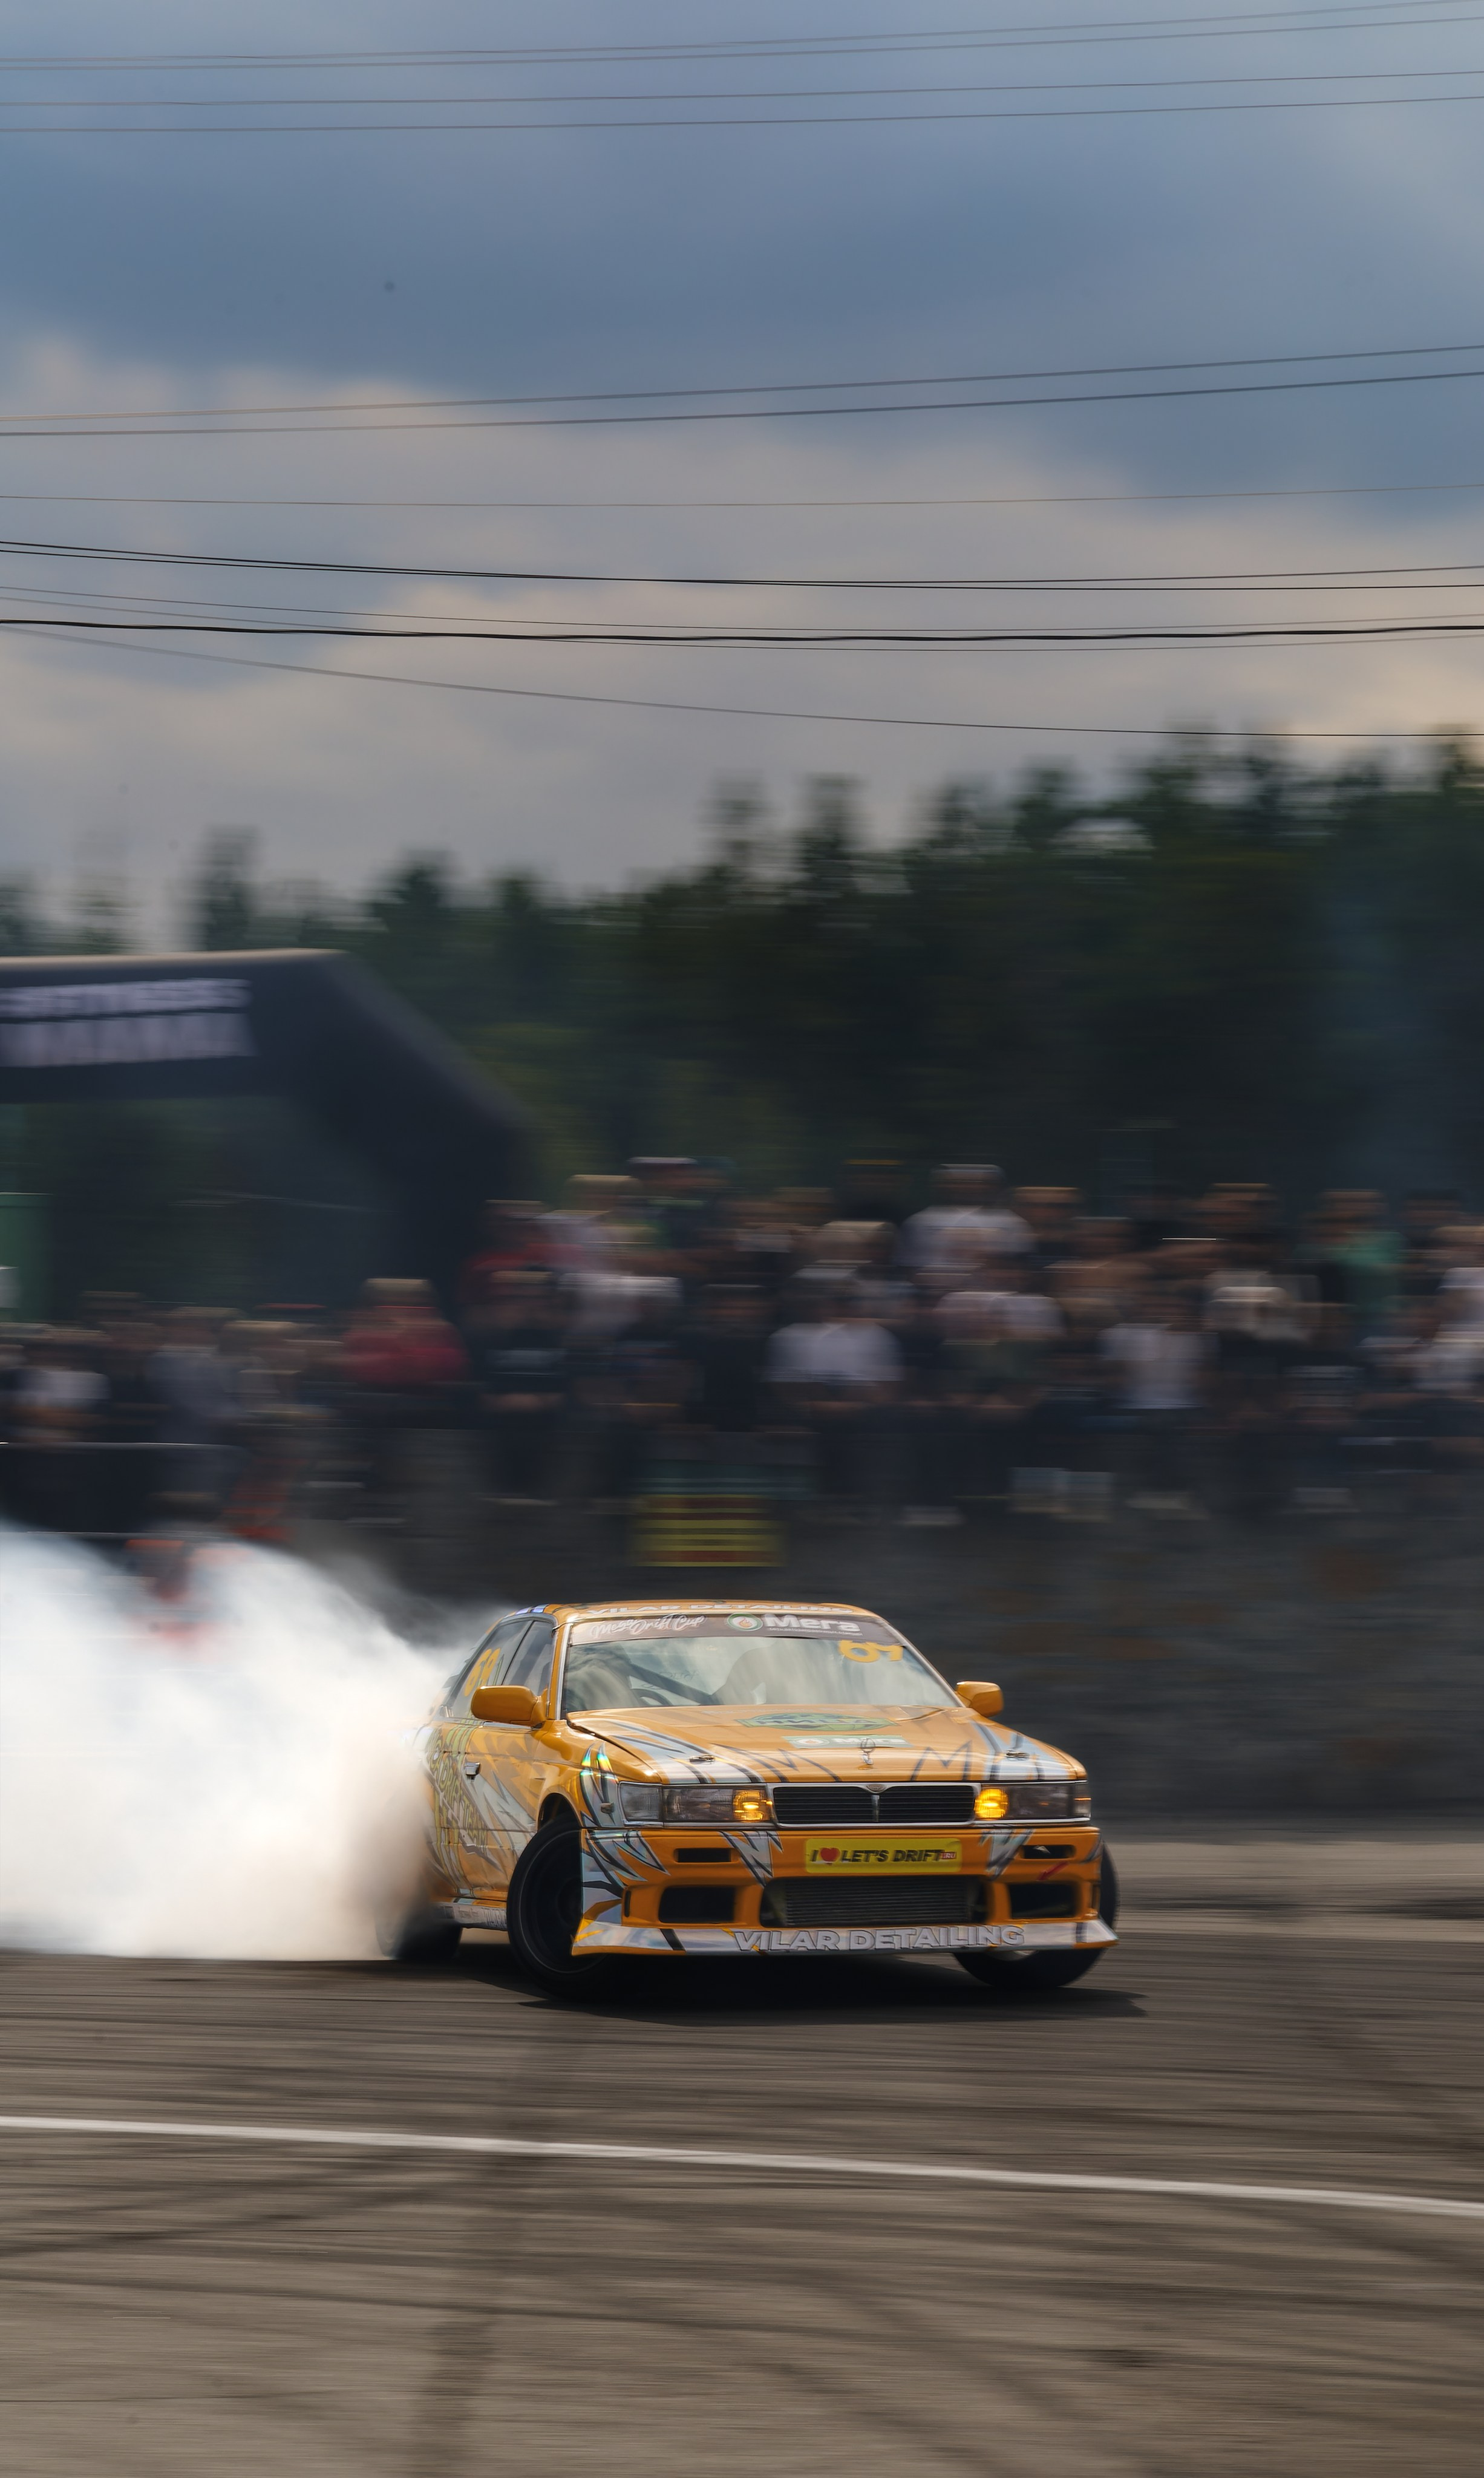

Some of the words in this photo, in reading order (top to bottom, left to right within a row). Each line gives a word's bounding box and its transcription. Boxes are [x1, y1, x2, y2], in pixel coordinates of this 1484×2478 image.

[586, 1605, 681, 1615] VILAR
[690, 1604, 852, 1613] DETAILING
[674, 1615, 705, 1631] Cup
[464, 1647, 501, 1696] 69
[841, 1849, 889, 1862] LET'S
[733, 1930, 840, 1951] VILAR
[848, 1926, 1024, 1950] DETAILING
